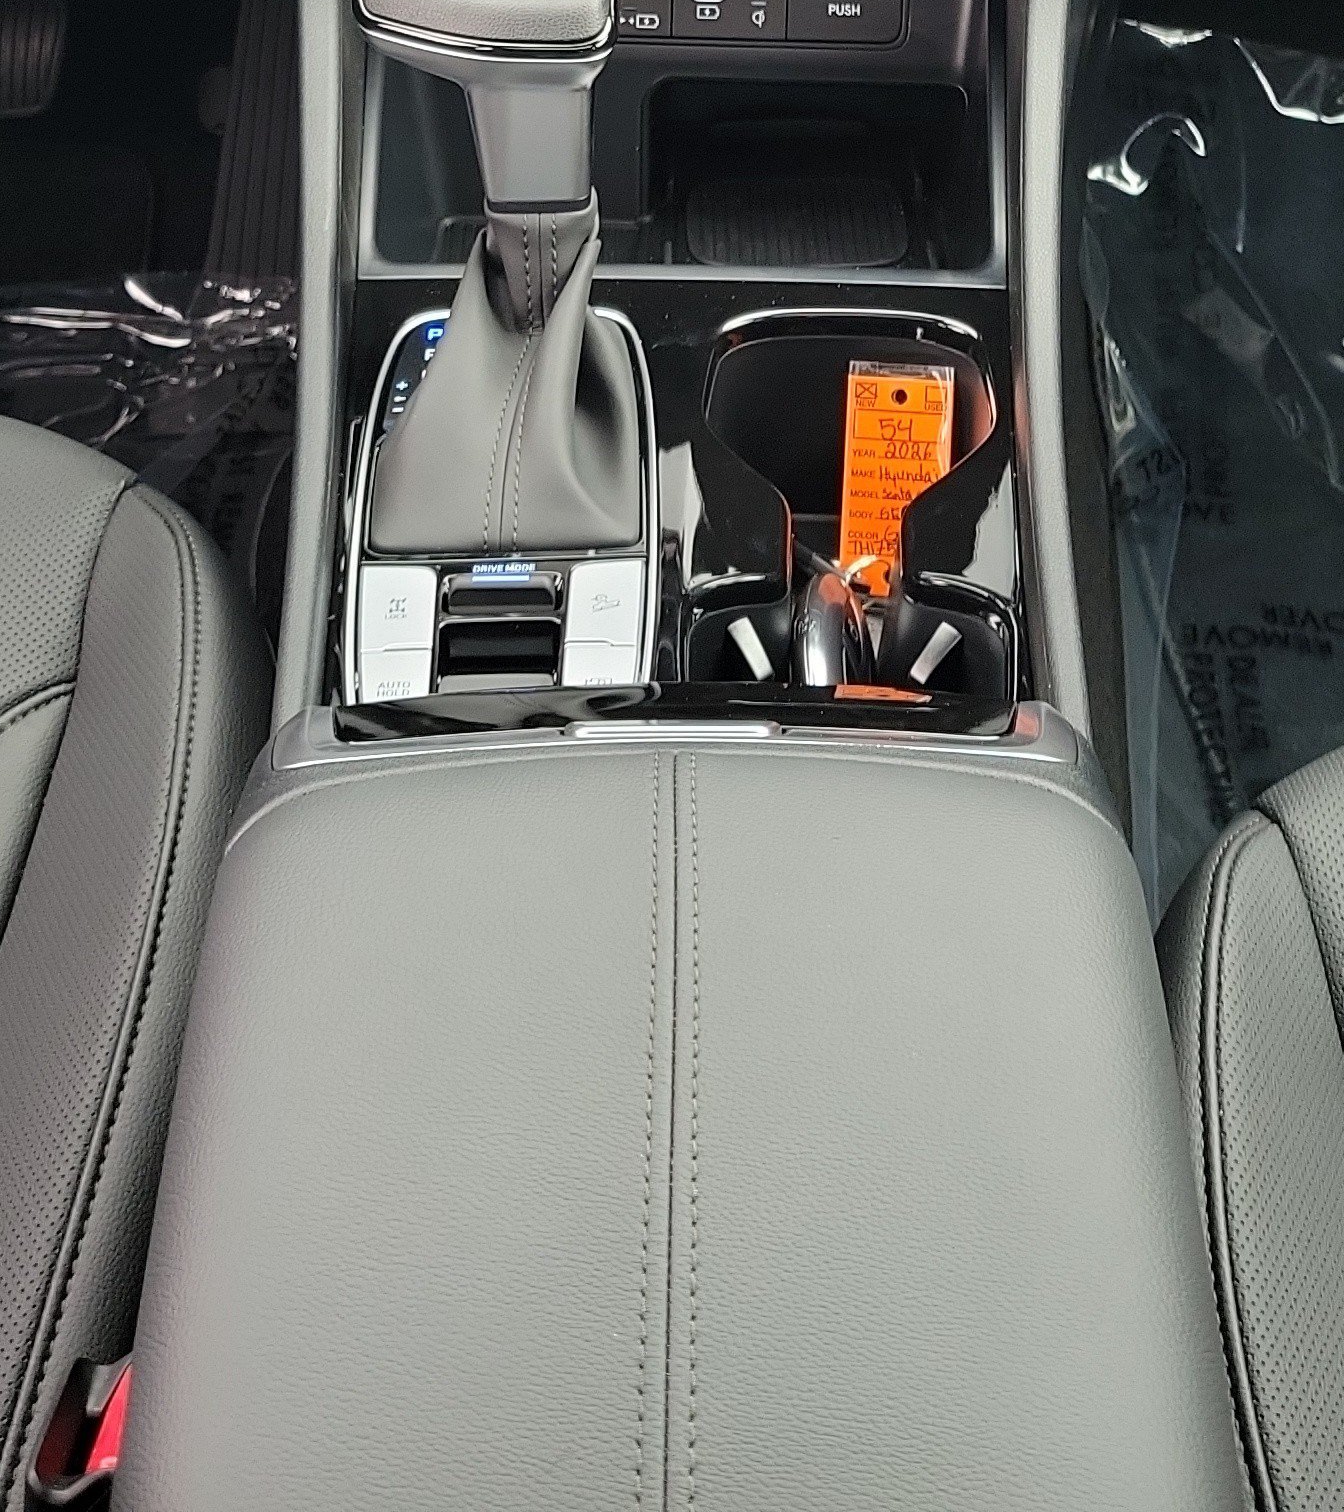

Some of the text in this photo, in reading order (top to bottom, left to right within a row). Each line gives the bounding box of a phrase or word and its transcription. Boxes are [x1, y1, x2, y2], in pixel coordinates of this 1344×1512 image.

[828, 3, 861, 17] PUSH
[855, 399, 875, 408] NEW
[924, 403, 946, 411] USED
[878, 418, 913, 442] 54
[852, 442, 932, 460] YEAR 2026
[851, 468, 875, 478] MAKE
[850, 488, 879, 499] MODEL
[849, 509, 873, 519] BODY
[848, 530, 879, 540] COLOR
[377, 681, 411, 689] AUTO
[376, 689, 410, 698] HOLD
